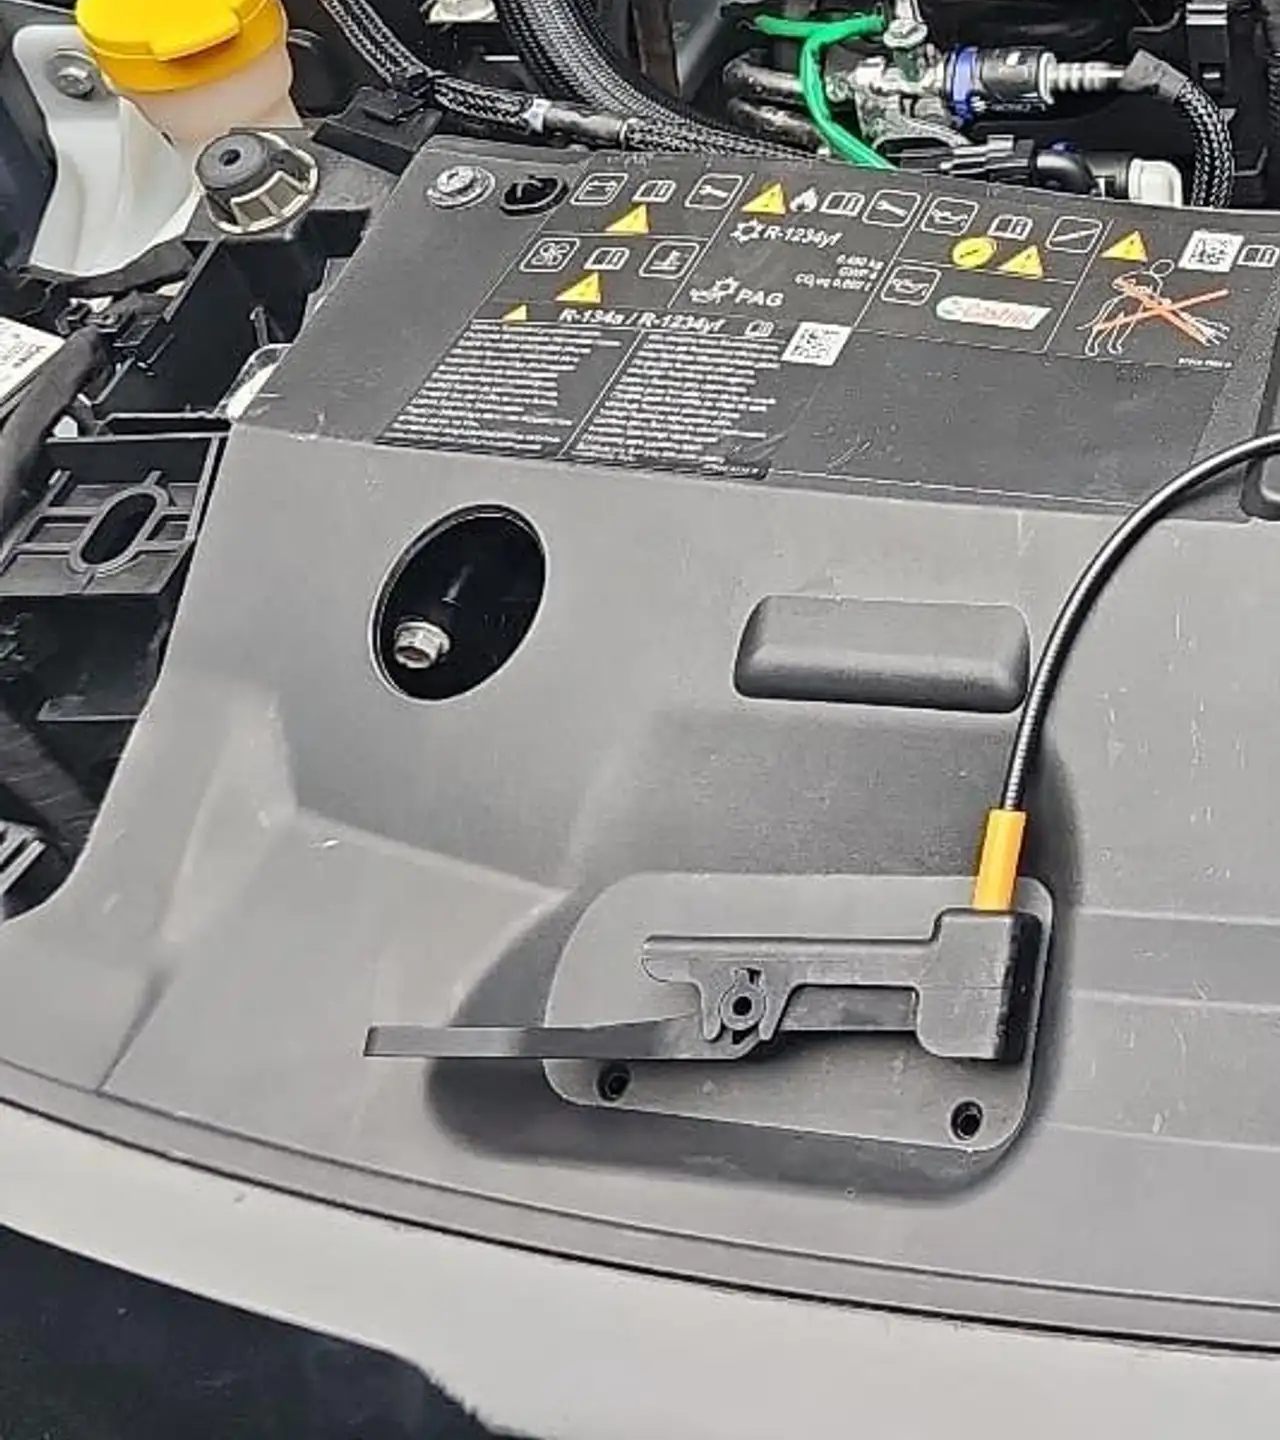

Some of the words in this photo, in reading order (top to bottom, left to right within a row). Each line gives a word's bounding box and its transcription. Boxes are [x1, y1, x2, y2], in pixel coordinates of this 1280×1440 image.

[763, 225, 843, 248] R-1234yf
[735, 287, 785, 307] PAG
[638, 313, 727, 334] R-1234yf
